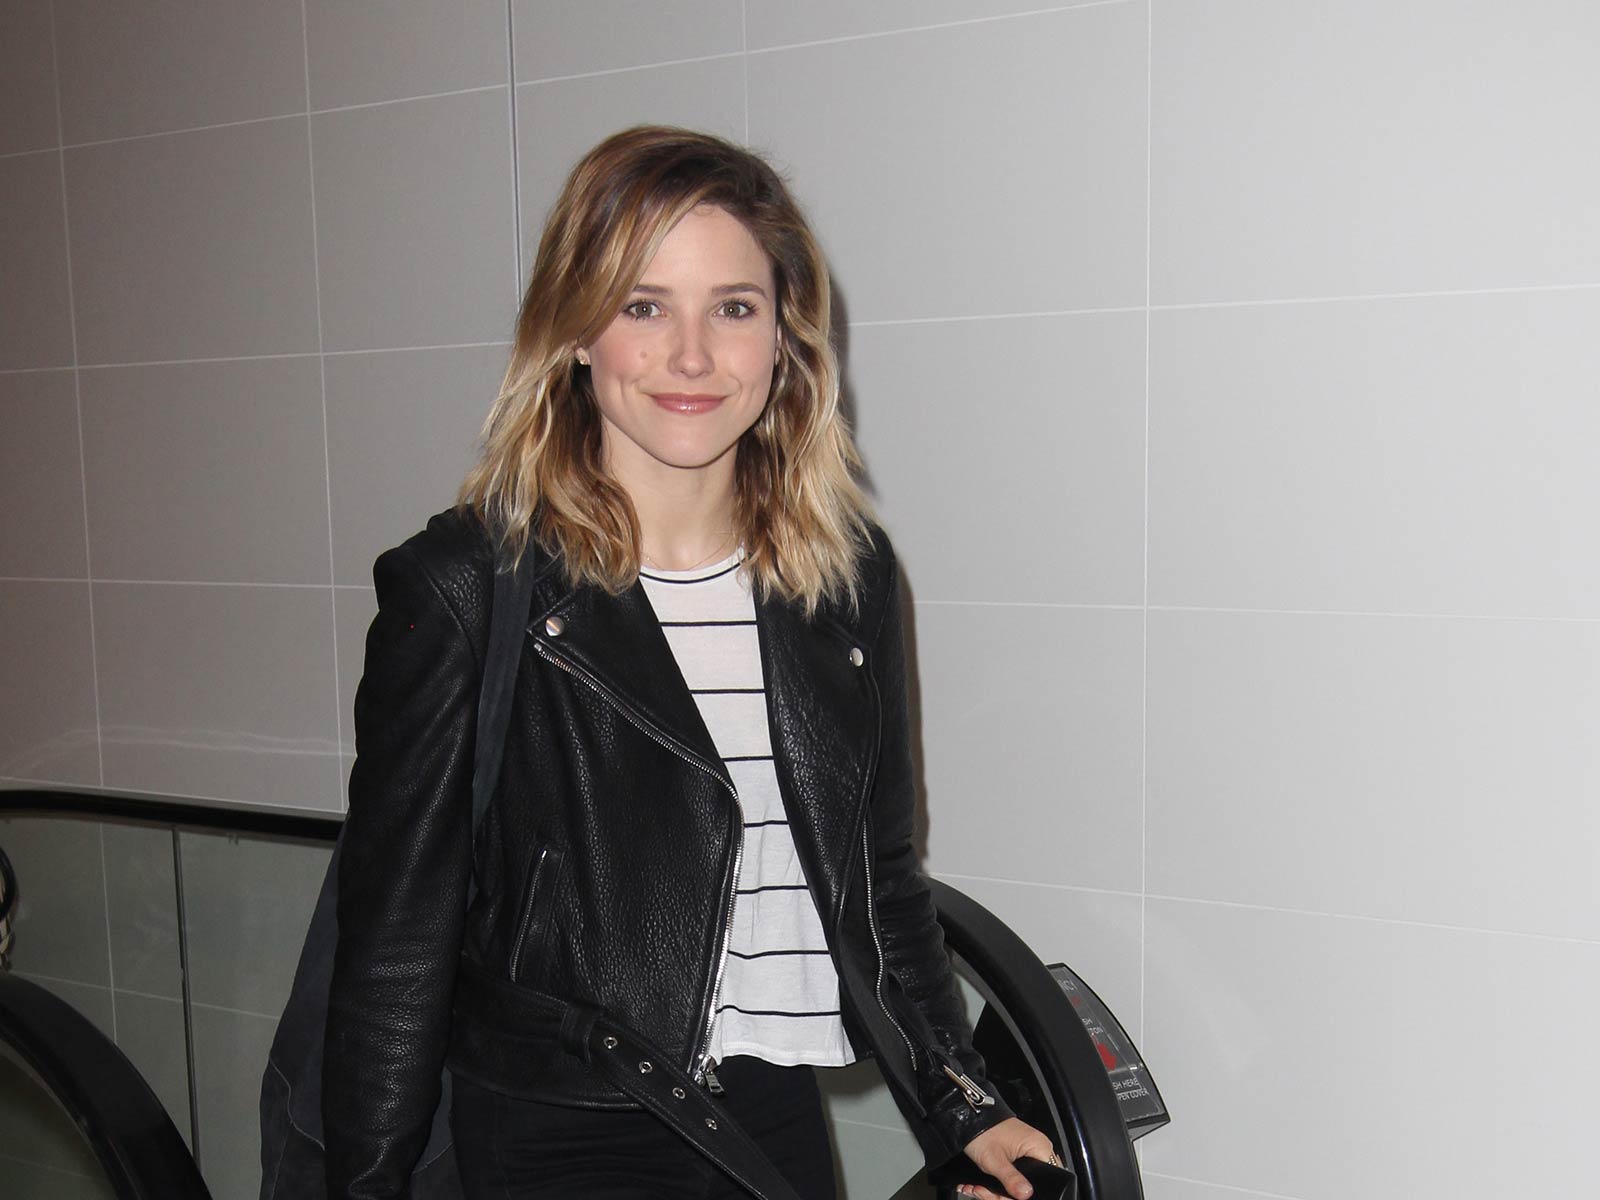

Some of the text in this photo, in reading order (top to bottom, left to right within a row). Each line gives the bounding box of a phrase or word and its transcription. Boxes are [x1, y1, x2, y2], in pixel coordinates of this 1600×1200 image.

[1112, 1077, 1139, 1090] SH HERE
[1130, 1088, 1149, 1099] COVER
